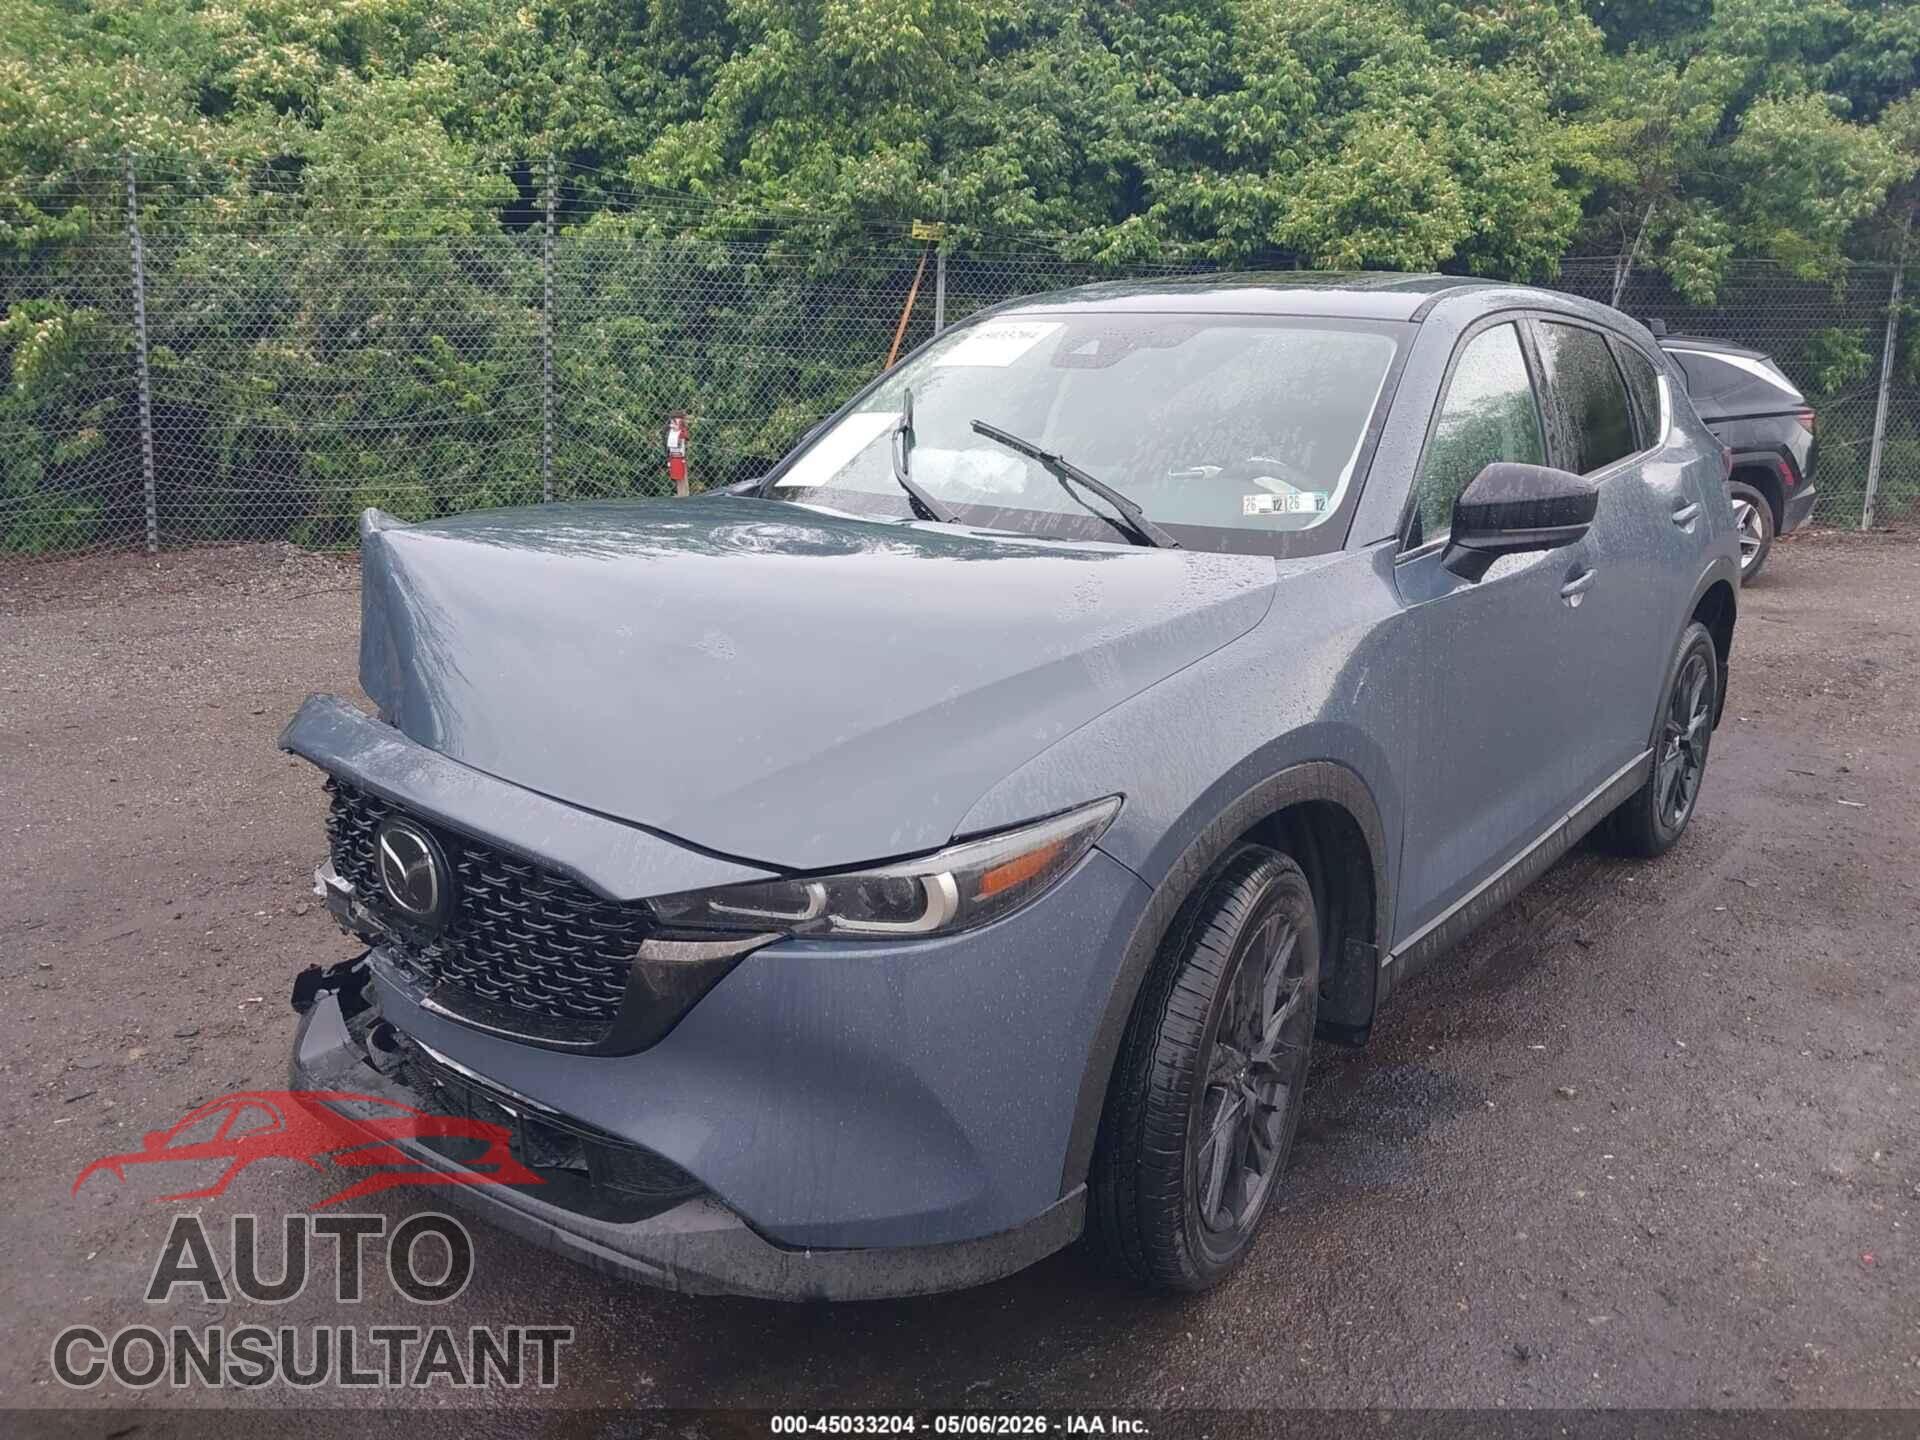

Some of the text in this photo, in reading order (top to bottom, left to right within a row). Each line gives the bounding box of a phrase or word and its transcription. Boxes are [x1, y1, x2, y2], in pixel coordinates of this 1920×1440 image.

[1272, 499, 1282, 511] 12
[1288, 496, 1325, 511] 26 12
